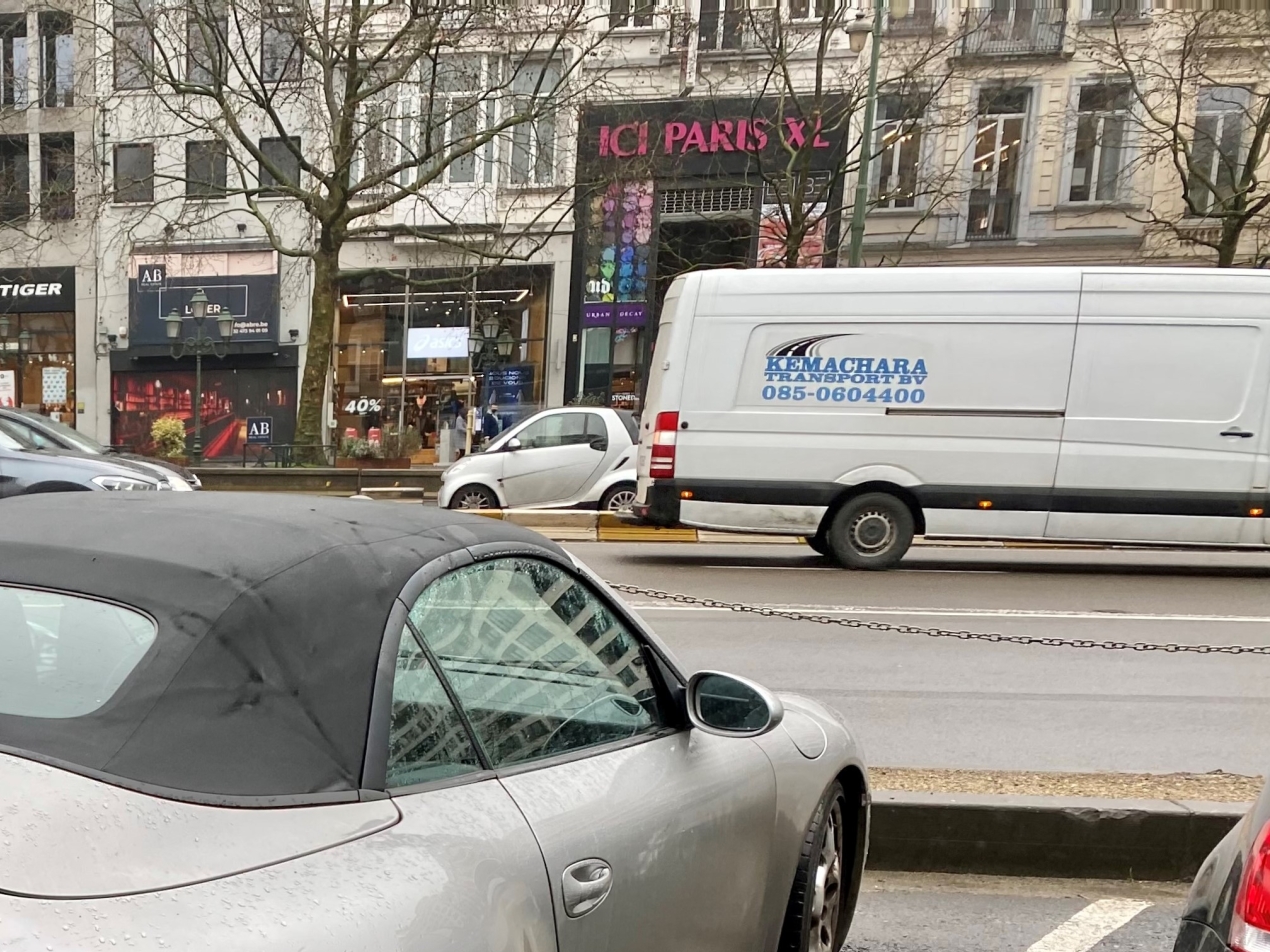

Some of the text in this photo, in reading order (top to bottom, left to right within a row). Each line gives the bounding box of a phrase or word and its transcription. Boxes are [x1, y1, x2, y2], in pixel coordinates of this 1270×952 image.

[598, 116, 830, 158] ICI PARIS XL
[141, 269, 163, 283] AB
[0, 283, 63, 297] TIGER
[185, 304, 221, 315] LER
[765, 356, 928, 375] KEMACHARA
[764, 372, 928, 385] TRANSPORT BV
[762, 385, 925, 404] 085-0604400
[344, 398, 382, 414] 40%
[249, 422, 270, 436] AB
